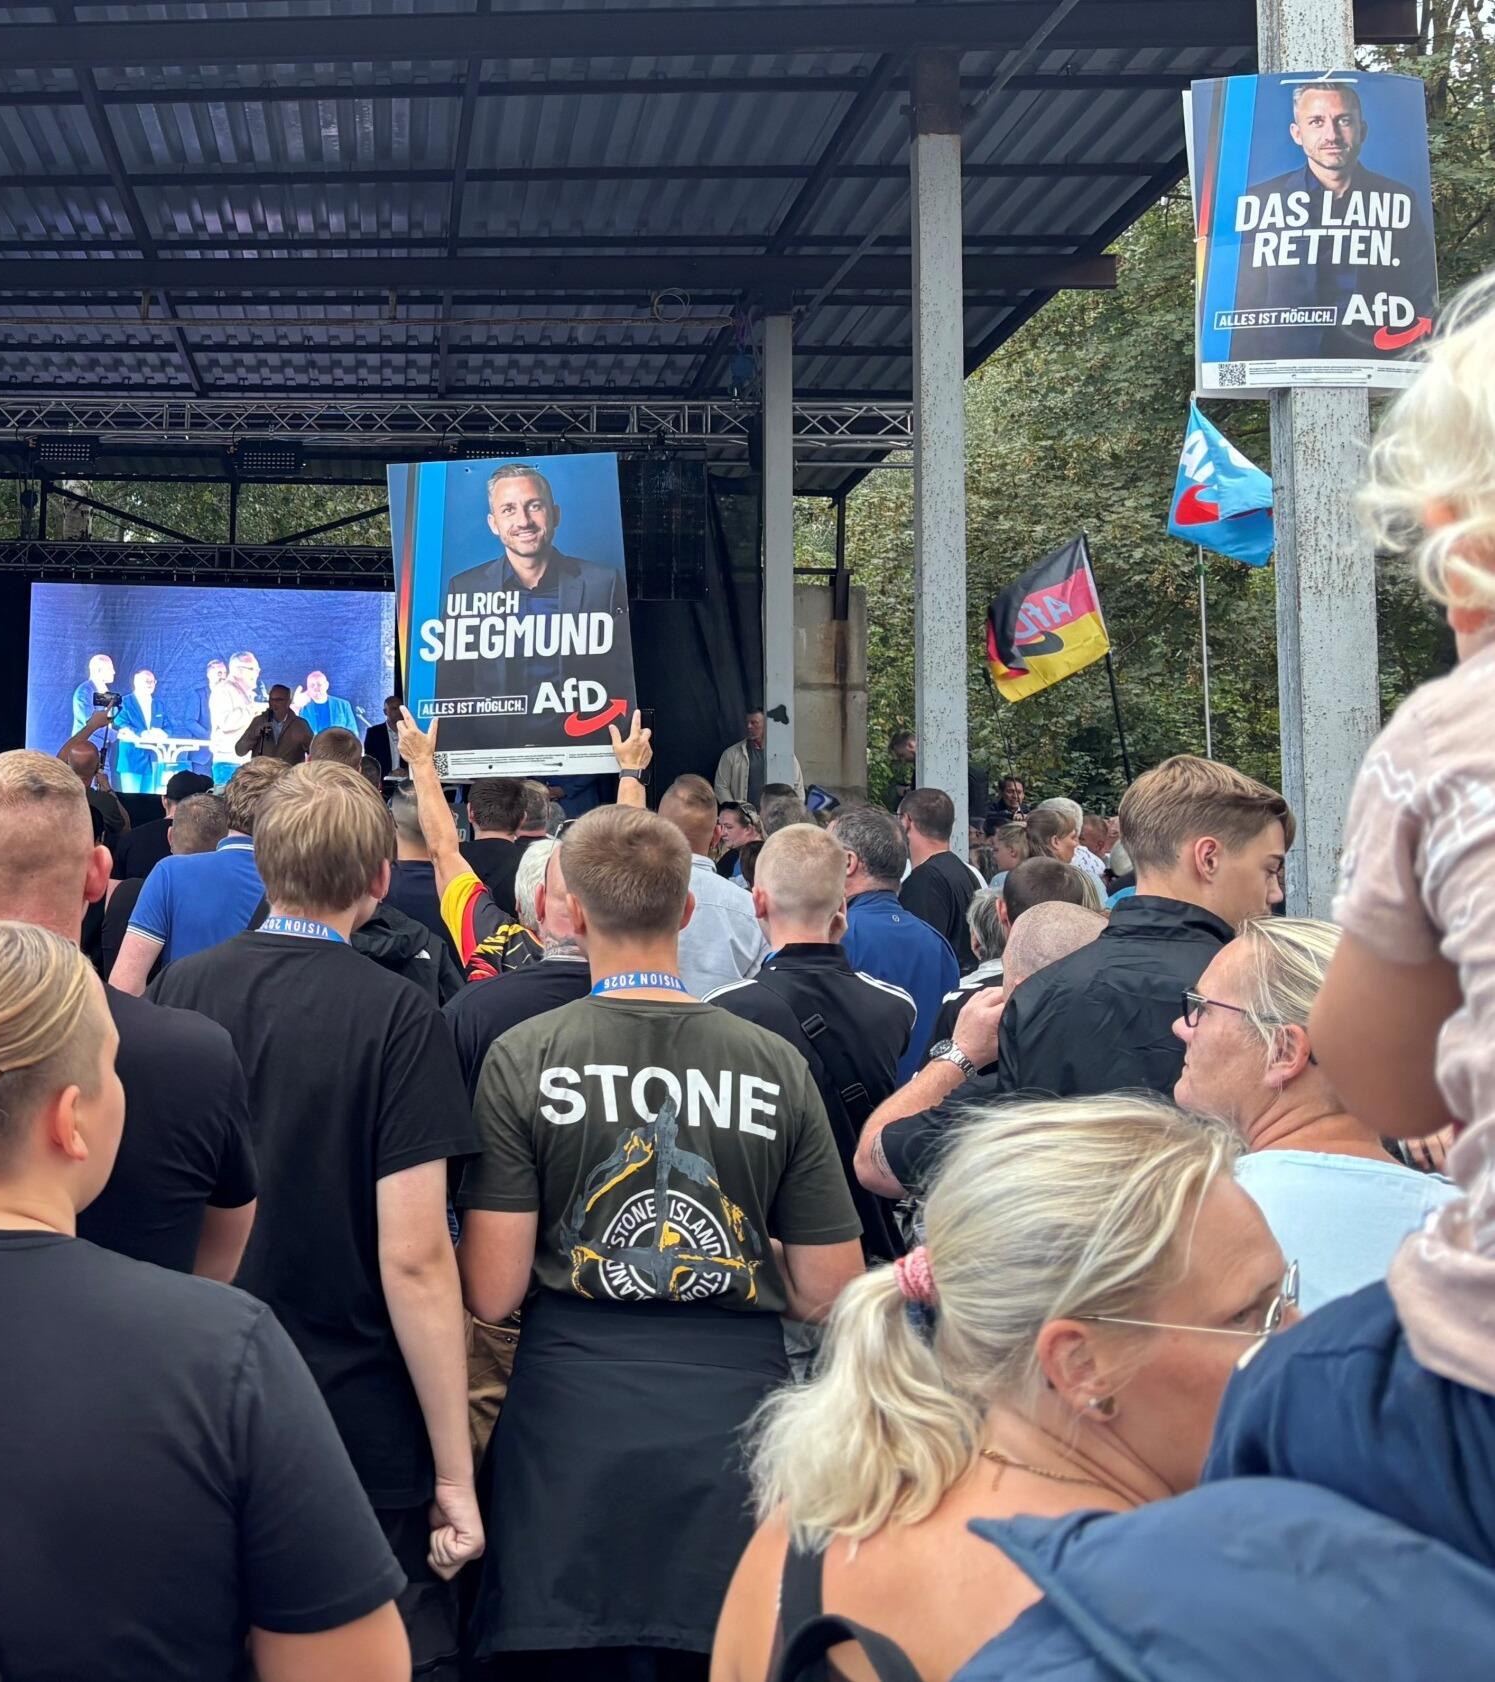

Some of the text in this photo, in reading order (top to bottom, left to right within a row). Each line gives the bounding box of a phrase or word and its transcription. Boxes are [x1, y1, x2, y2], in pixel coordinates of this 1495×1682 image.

[1234, 190, 1411, 232] DAS LAND
[1251, 228, 1401, 268] RETTEN.
[1218, 307, 1333, 327] ALLES IST MÖGLICH.
[1341, 291, 1415, 328] AfD
[446, 591, 520, 617] ULRICH
[419, 611, 614, 663] SIEGMUND
[422, 697, 525, 715] ALLES IST MÖGLICH.
[532, 677, 608, 714] AfD
[261, 918, 329, 938] VISION 202
[604, 973, 682, 989] VISION 2026
[539, 1063, 781, 1141] STONE
[610, 1197, 722, 1257] STONE ISLAND
